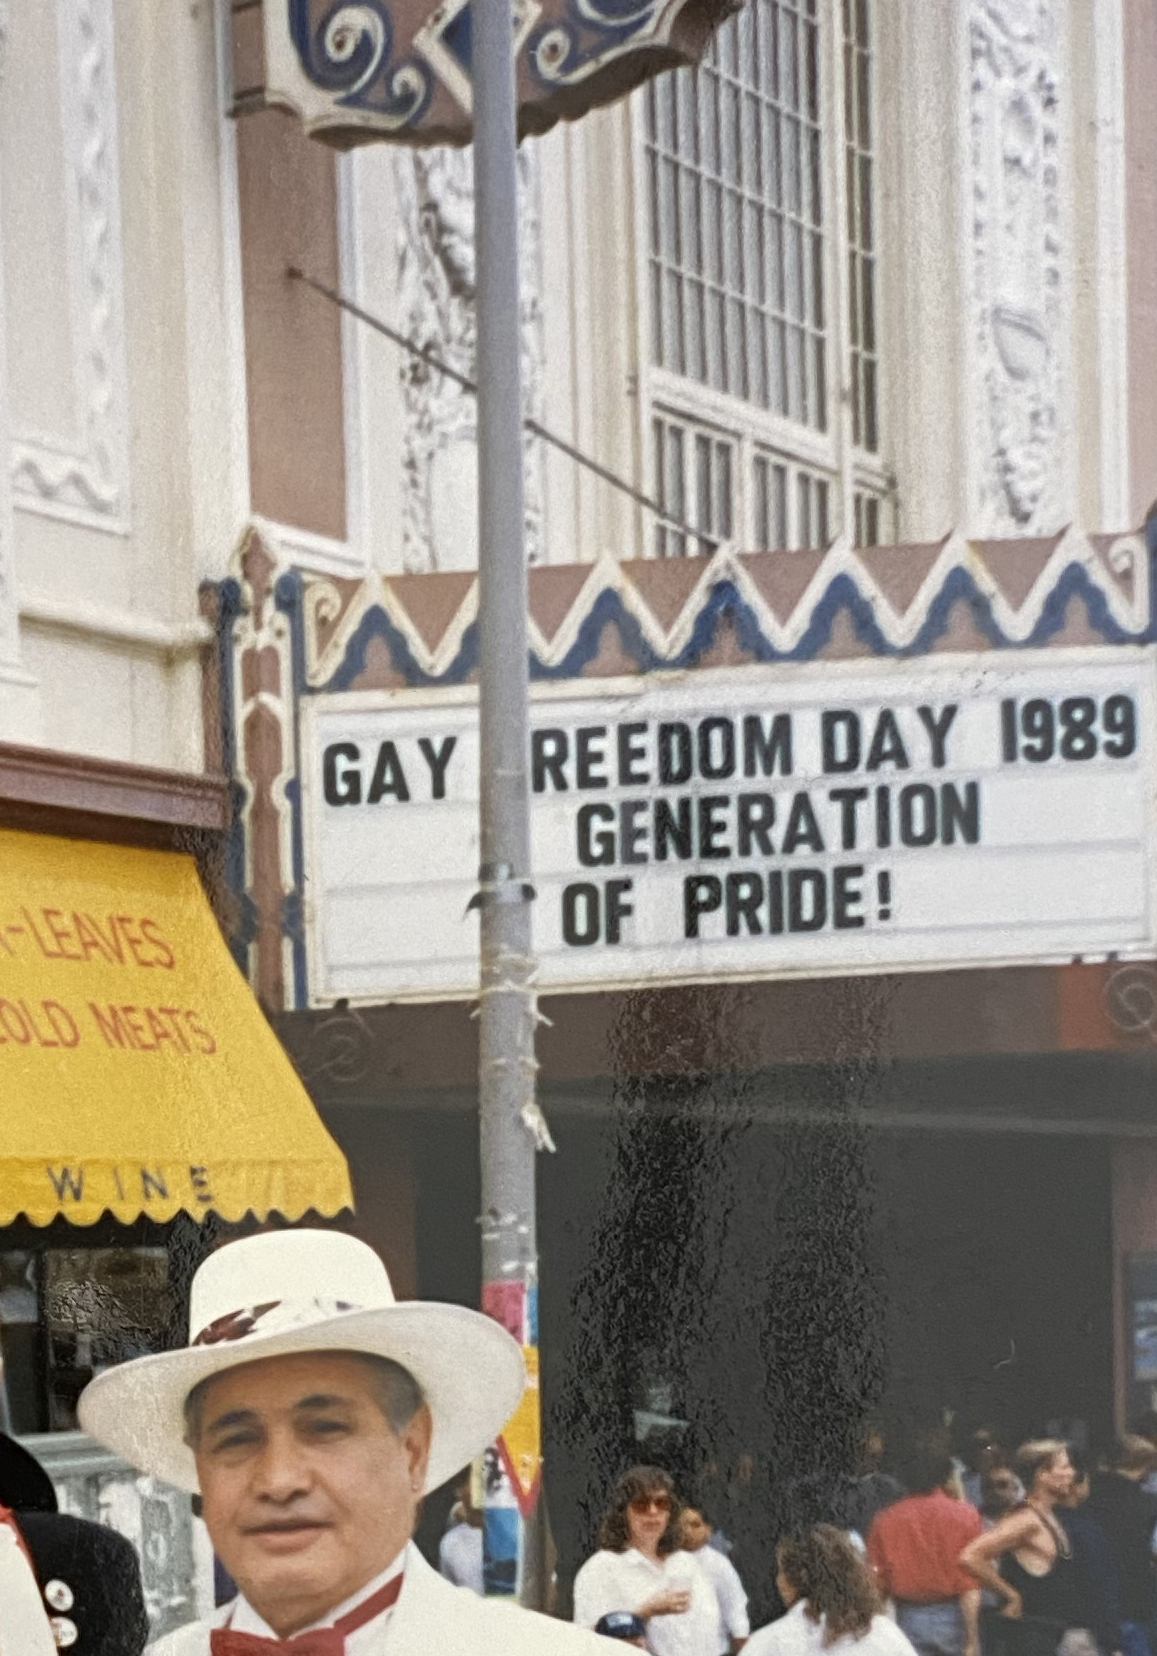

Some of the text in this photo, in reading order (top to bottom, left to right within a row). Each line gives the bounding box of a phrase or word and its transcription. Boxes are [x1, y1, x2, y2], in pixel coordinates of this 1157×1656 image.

[323, 694, 1137, 807] GAY REEDOM DAY 1989
[577, 780, 981, 867] GENERATION
[562, 866, 893, 947] OF PRIDE!
[89, 1001, 218, 1055] MEATS
[45, 1163, 214, 1203] WINE
